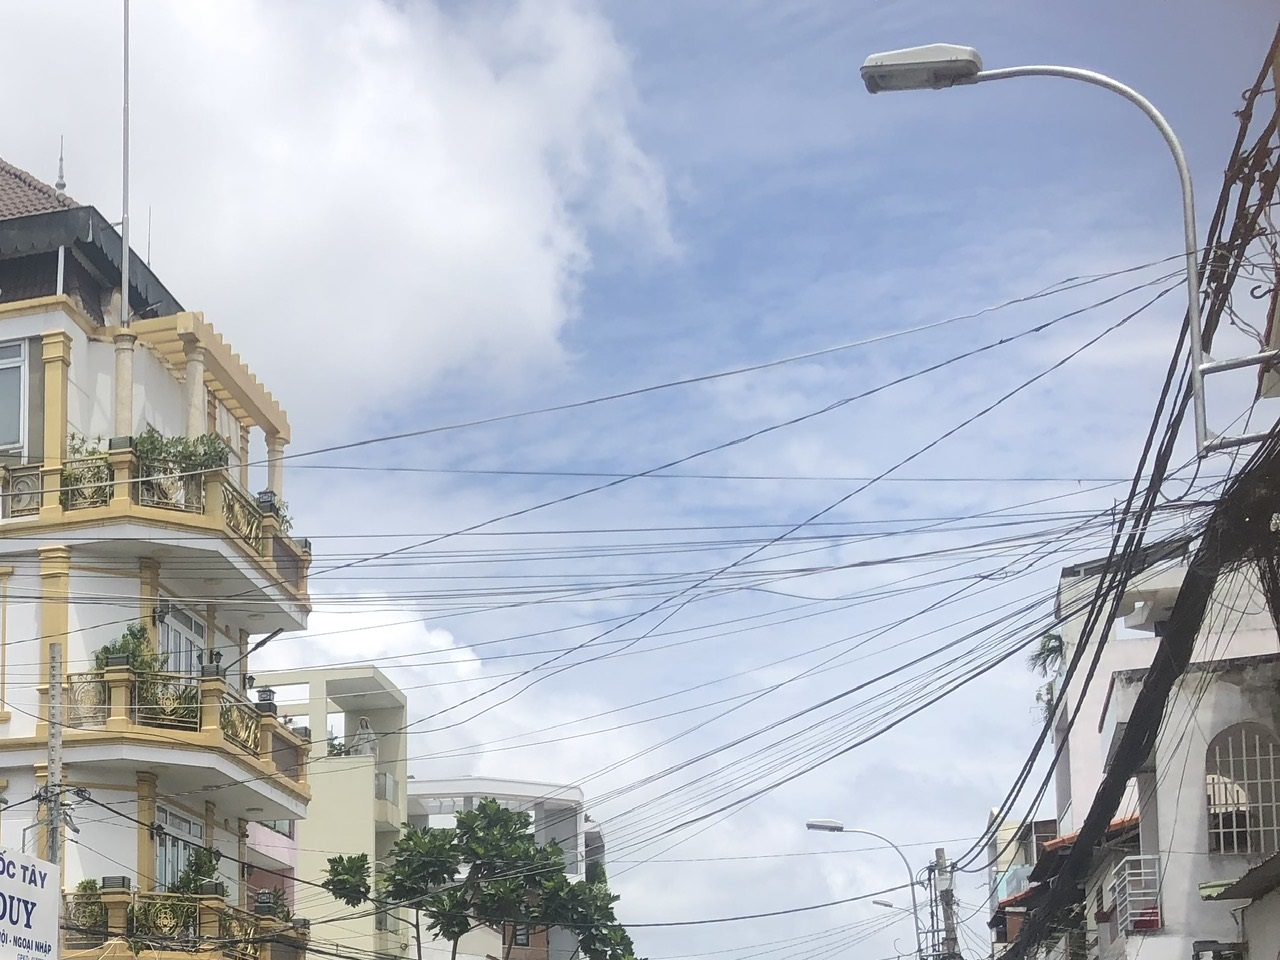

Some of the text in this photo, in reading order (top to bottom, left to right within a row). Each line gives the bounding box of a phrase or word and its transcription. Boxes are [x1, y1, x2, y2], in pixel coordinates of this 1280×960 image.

[20, 864, 48, 889] TÂY
[13, 935, 33, 953] NGOẠI
[35, 940, 52, 957] NHẬP
